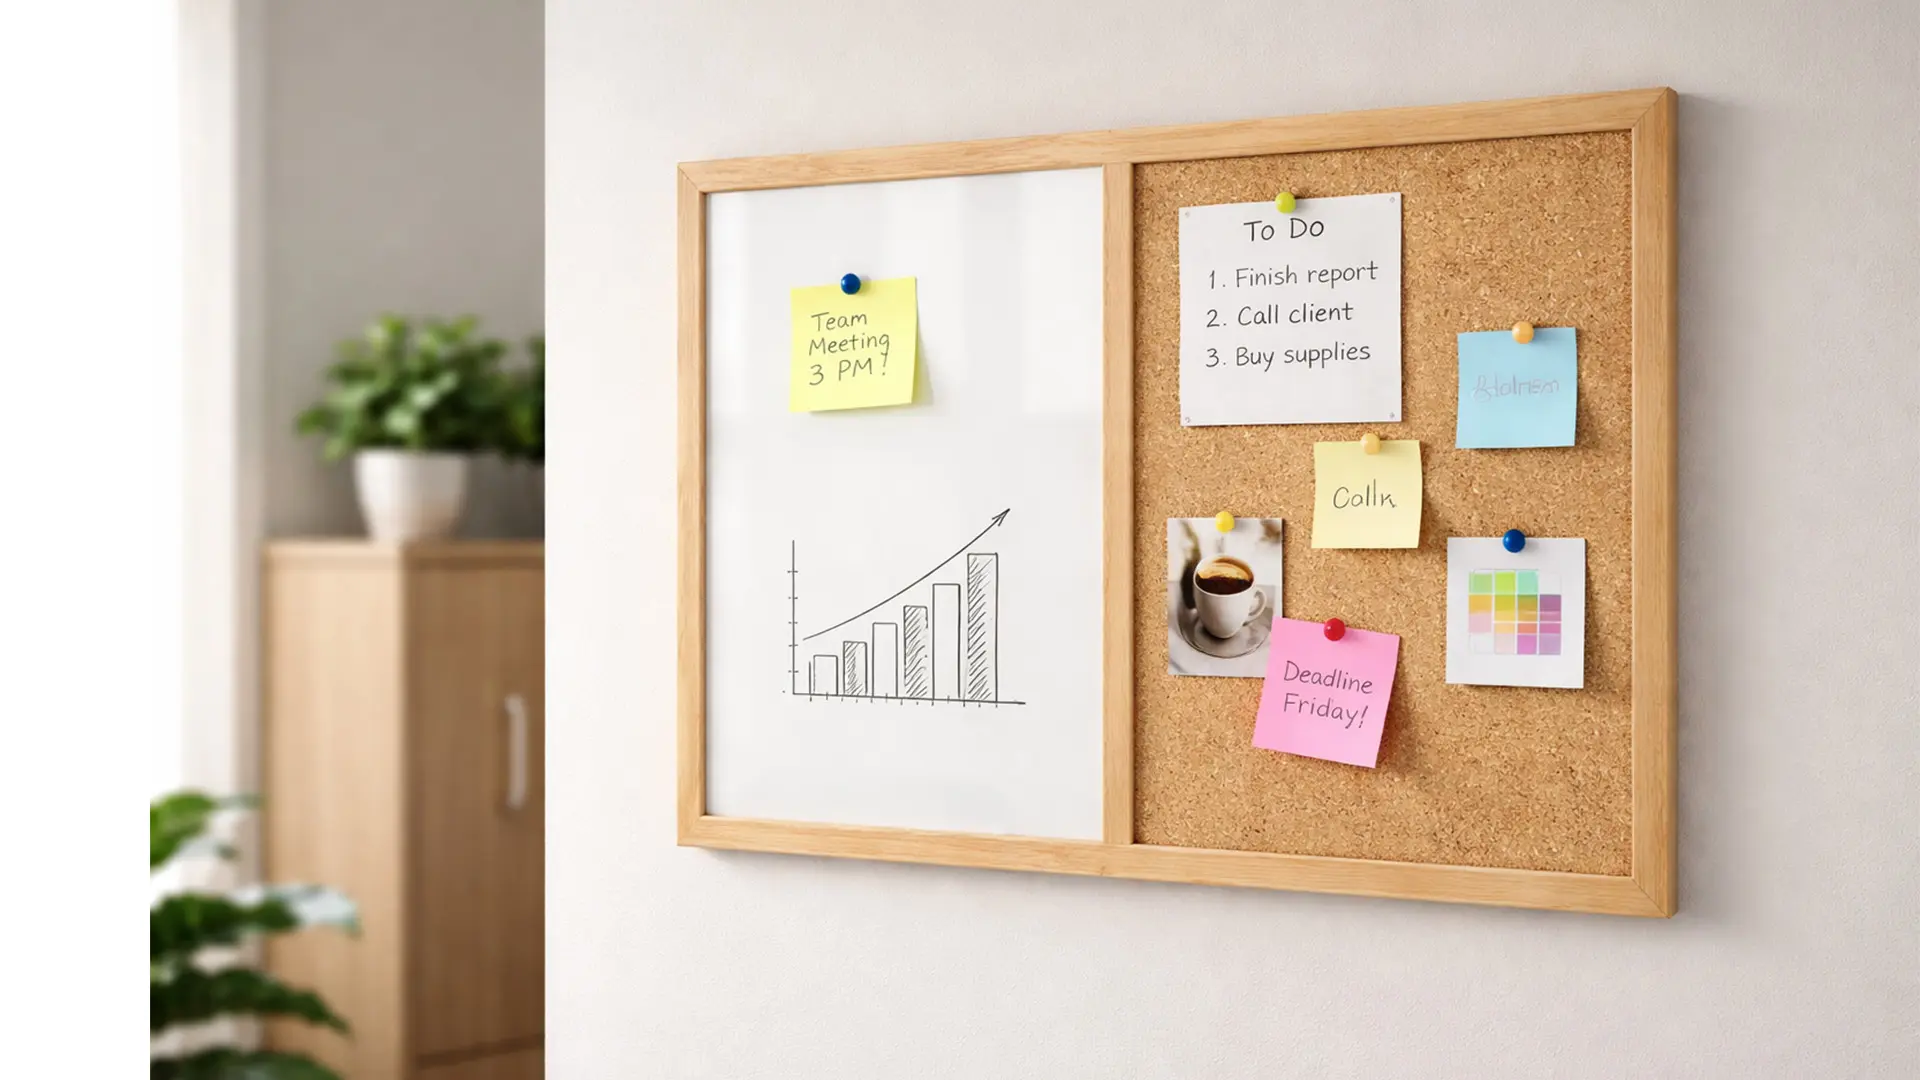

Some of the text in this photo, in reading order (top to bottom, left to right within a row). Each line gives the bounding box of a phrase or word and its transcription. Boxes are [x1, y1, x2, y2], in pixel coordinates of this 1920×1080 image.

[1243, 217, 1325, 242] To Do
[1209, 260, 1379, 290] 1. Finish report
[811, 311, 867, 332] Team
[1206, 302, 1354, 328] 2. Call client
[808, 332, 890, 357] Meeting
[1205, 341, 1371, 372] 3. Buy supplies
[809, 363, 825, 386] 3
[1283, 660, 1373, 694] Deadline
[1283, 692, 1369, 730] Friday!
